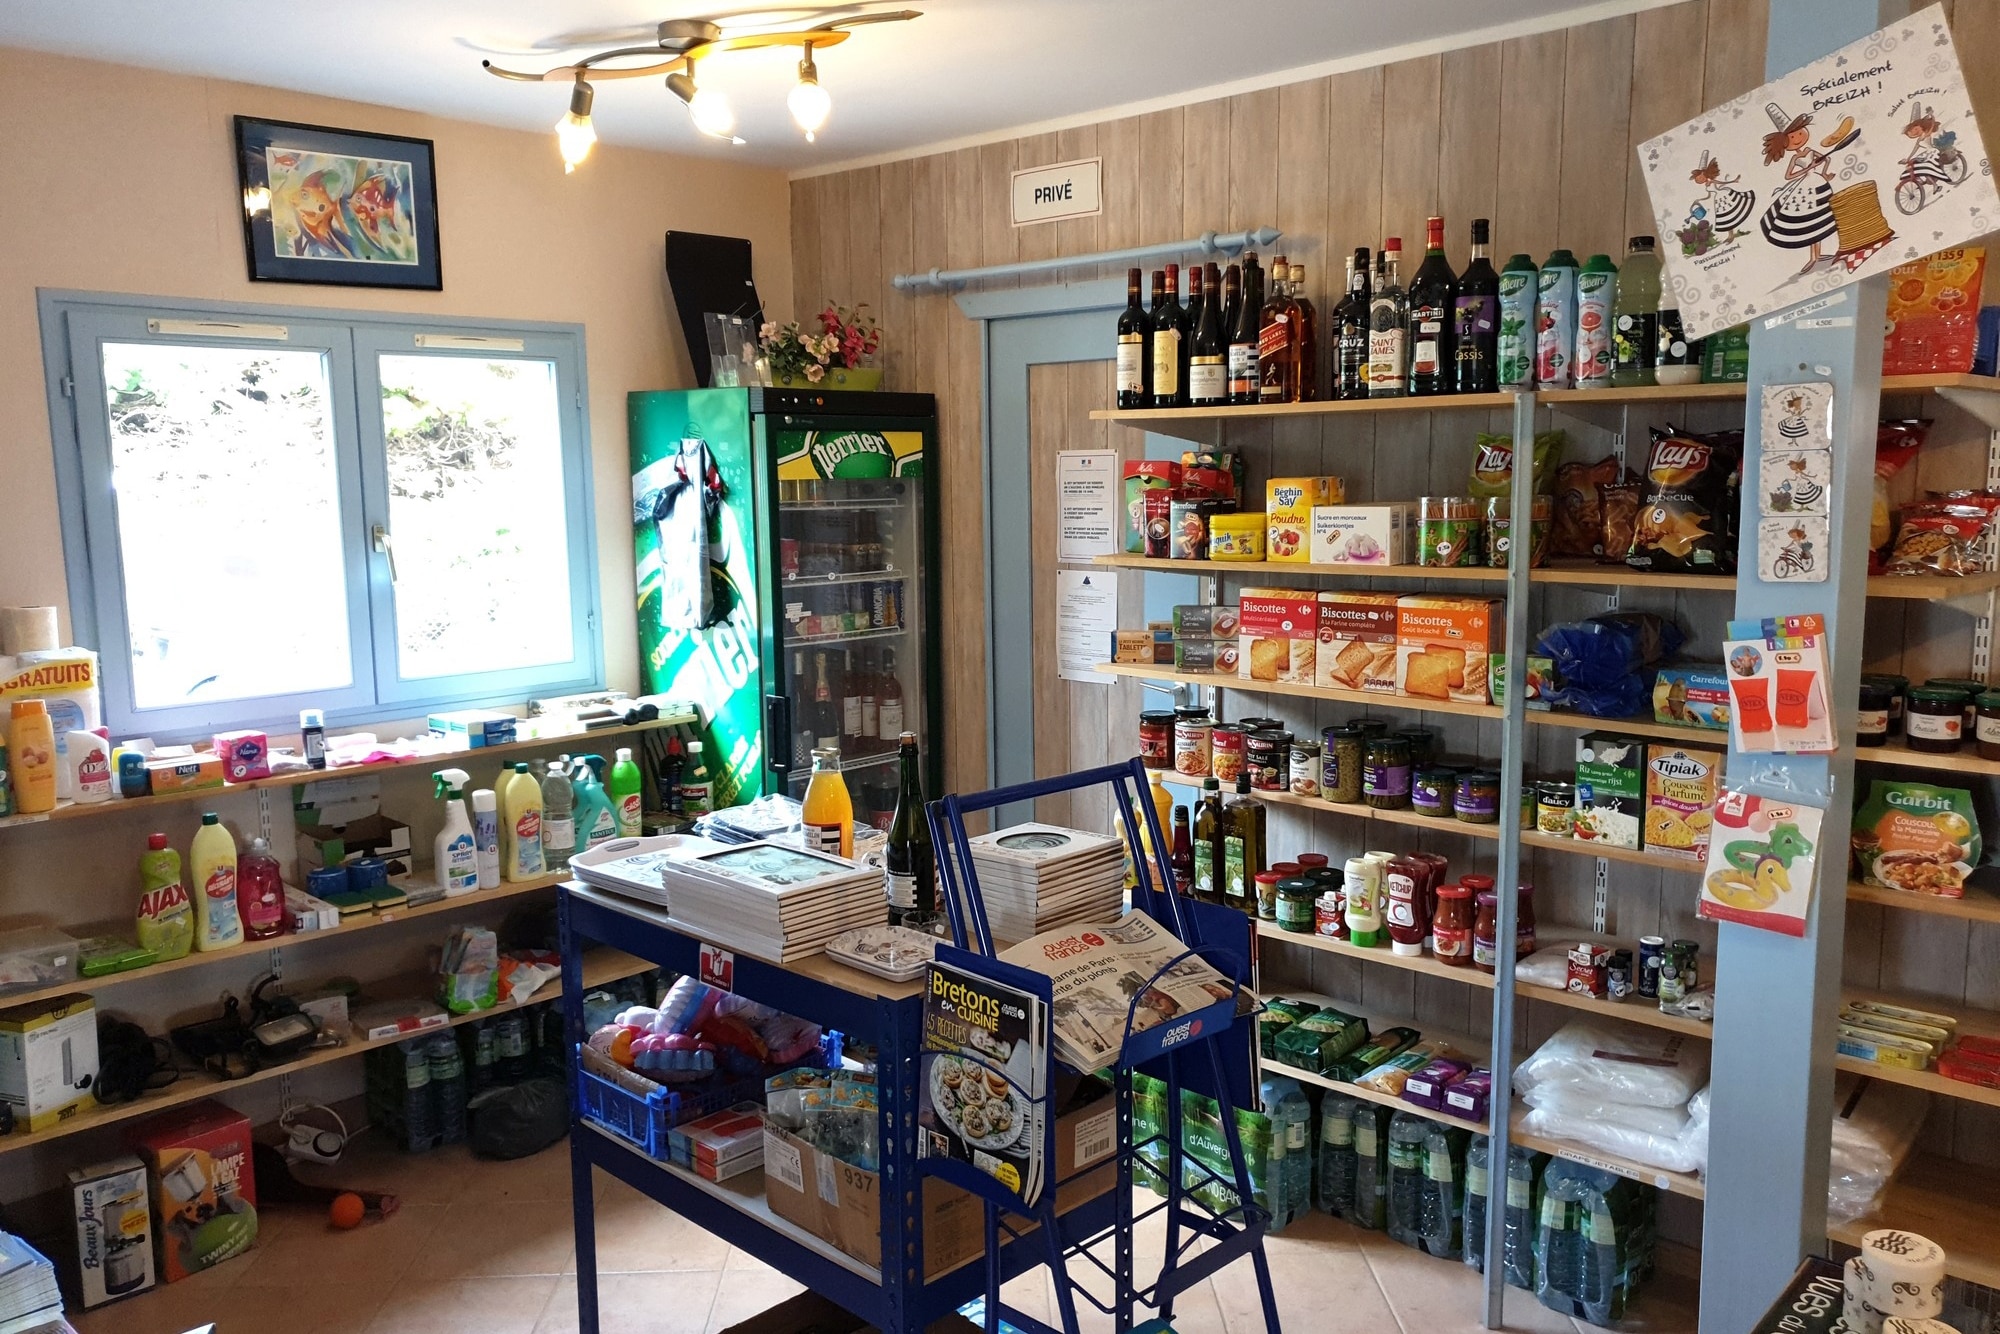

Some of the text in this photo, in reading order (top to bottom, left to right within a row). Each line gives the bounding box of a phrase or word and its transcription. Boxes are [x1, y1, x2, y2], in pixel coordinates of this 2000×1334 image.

[1800, 60, 1893, 97] Spécialement
[1813, 86, 1871, 111] BREIZH
[1035, 179, 1072, 204] PRIVÉ
[1412, 310, 1442, 319] MARTINI
[1339, 338, 1365, 349] CRUZ
[1370, 338, 1395, 347] SAINT
[1370, 346, 1395, 356] JAMES
[1455, 349, 1484, 361] Cassis
[1274, 487, 1303, 499] Béghin
[1646, 494, 1695, 503] Barbecue
[1278, 496, 1297, 508] Say
[1270, 512, 1306, 524] Poudre
[873, 587, 883, 626] ORANGINA
[1243, 601, 1287, 614] Biscottes
[1321, 606, 1367, 620] Biscottes
[1348, 621, 1376, 629] complète
[1402, 612, 1453, 627] Biscottes
[1769, 639, 1814, 650] INTEX
[1690, 674, 1729, 685] Carrefour
[178, 764, 198, 774] Nett
[1579, 764, 1590, 774] Riz
[1657, 760, 1701, 776] Tipiak
[1608, 777, 1622, 786] rijst
[1662, 778, 1708, 792] Couscous
[1663, 786, 1707, 802] Parfumé
[1886, 790, 1952, 811] Garbit
[137, 883, 189, 920] AJAX
[1043, 935, 1082, 953] ouest
[1044, 943, 1090, 961] france
[1077, 962, 1089, 973] de
[1090, 956, 1115, 968] Paris
[1075, 976, 1088, 987] du
[1088, 966, 1118, 981] plomb
[933, 970, 1000, 1018] Bretons
[941, 1000, 956, 1012] en
[957, 1005, 999, 1032] CUISINE
[926, 1012, 967, 1044] 65 RECETTES
[1166, 1021, 1191, 1037] ouest
[1161, 1031, 1189, 1048] france
[210, 1152, 245, 1176] LAMPE
[1559, 1150, 1639, 1178] DRAPS JETABLES
[221, 1167, 240, 1184] GAZ
[844, 1168, 873, 1193] 937
[79, 1189, 102, 1269] Beaux Jours
